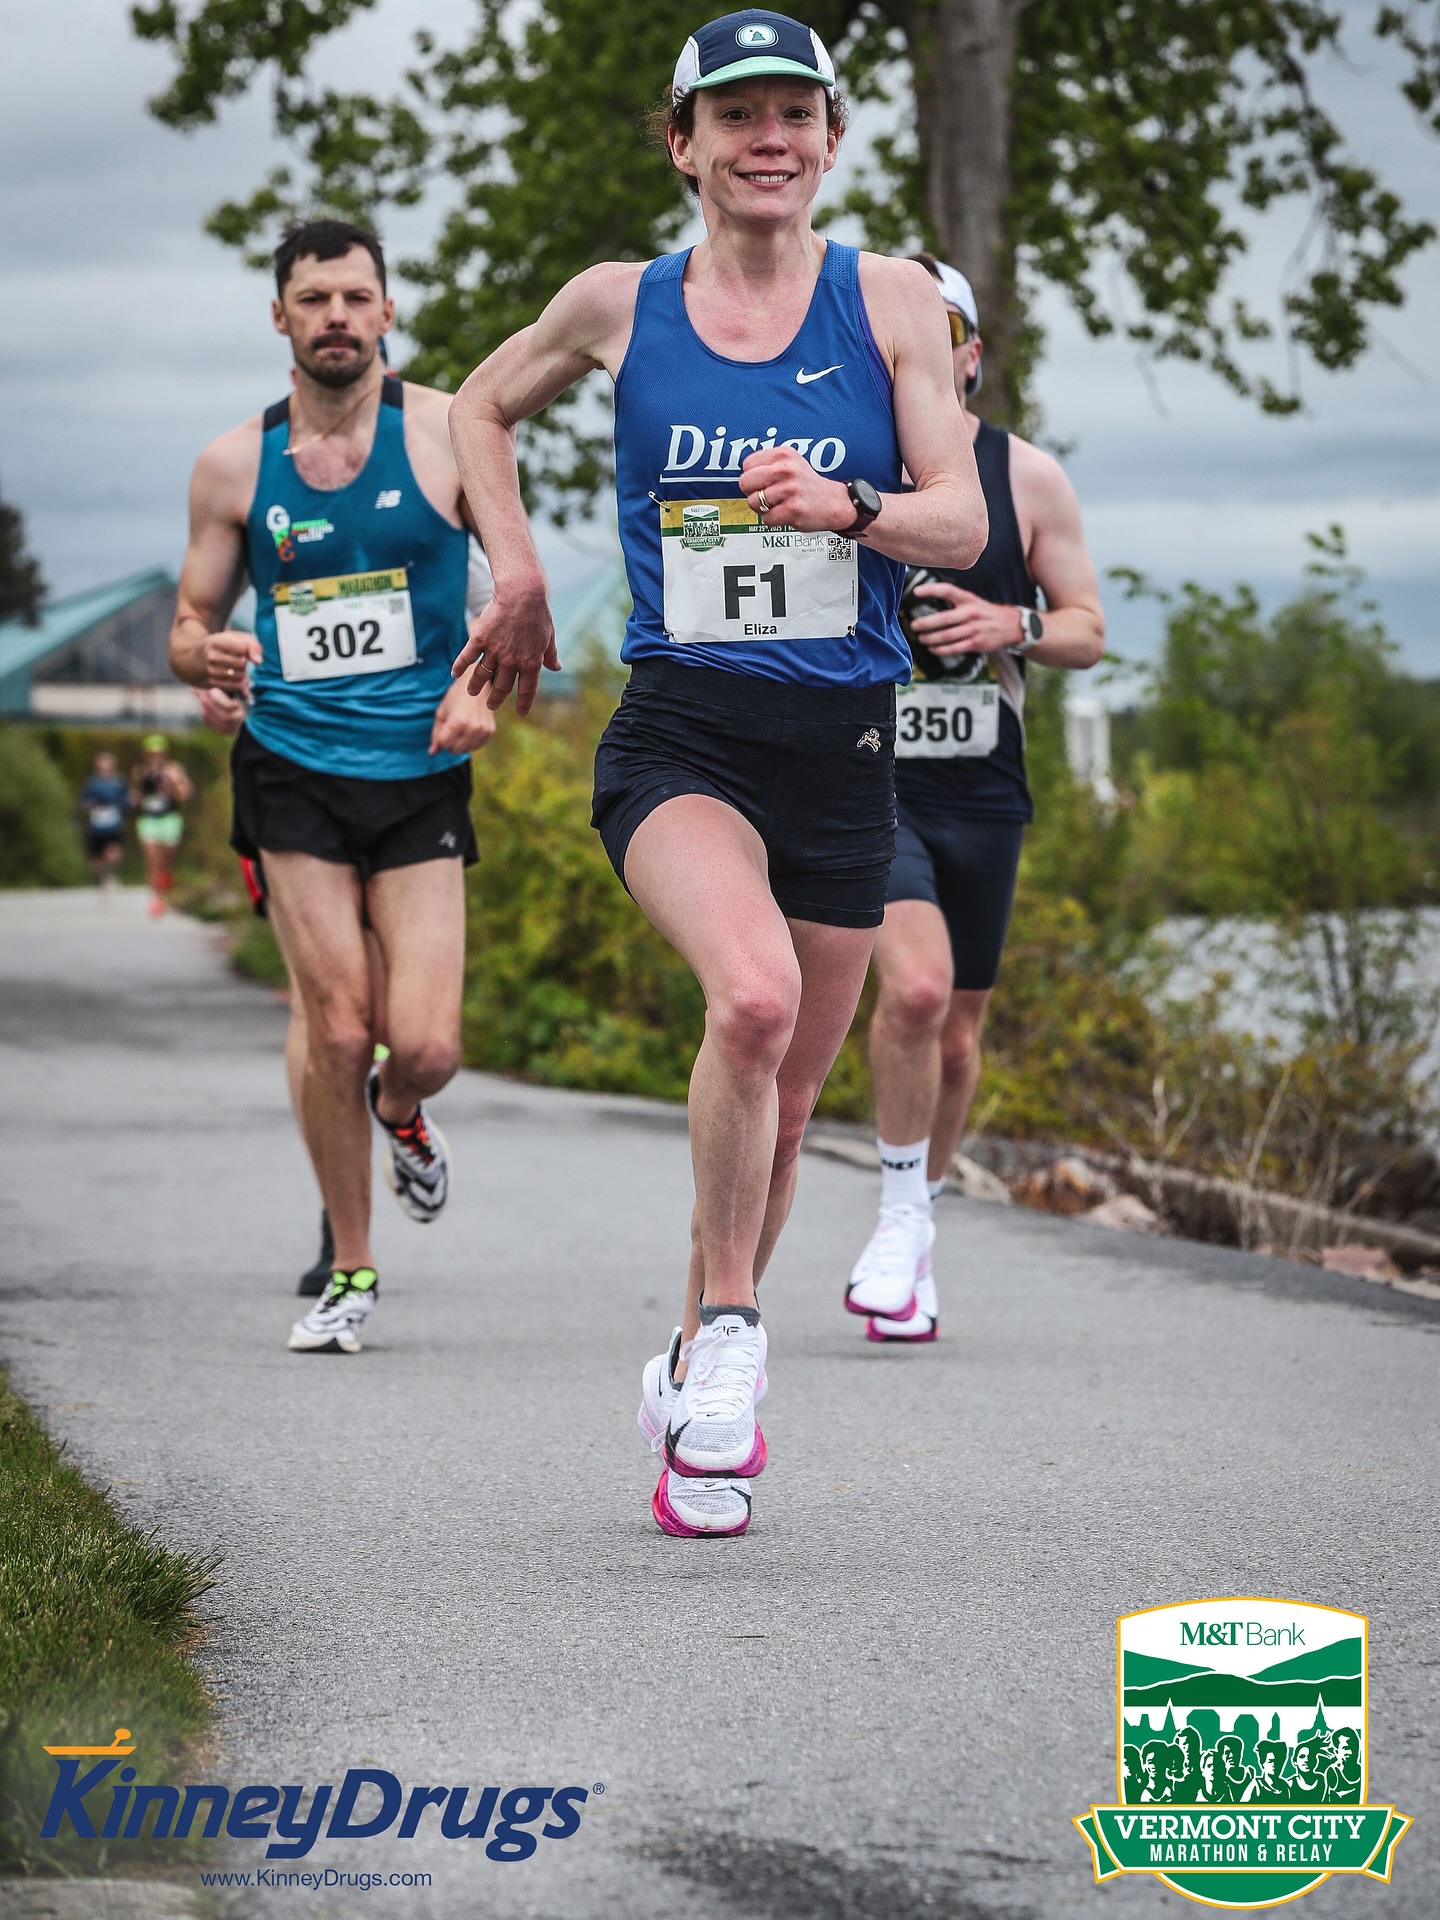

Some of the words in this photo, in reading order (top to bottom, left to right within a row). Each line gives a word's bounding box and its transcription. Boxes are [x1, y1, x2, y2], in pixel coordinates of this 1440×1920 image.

[762, 535, 793, 548] M&T
[794, 534, 824, 547] Bank
[723, 564, 787, 620] F1
[307, 620, 383, 662] 302
[744, 623, 778, 636] Eliza
[900, 707, 973, 743] 350
